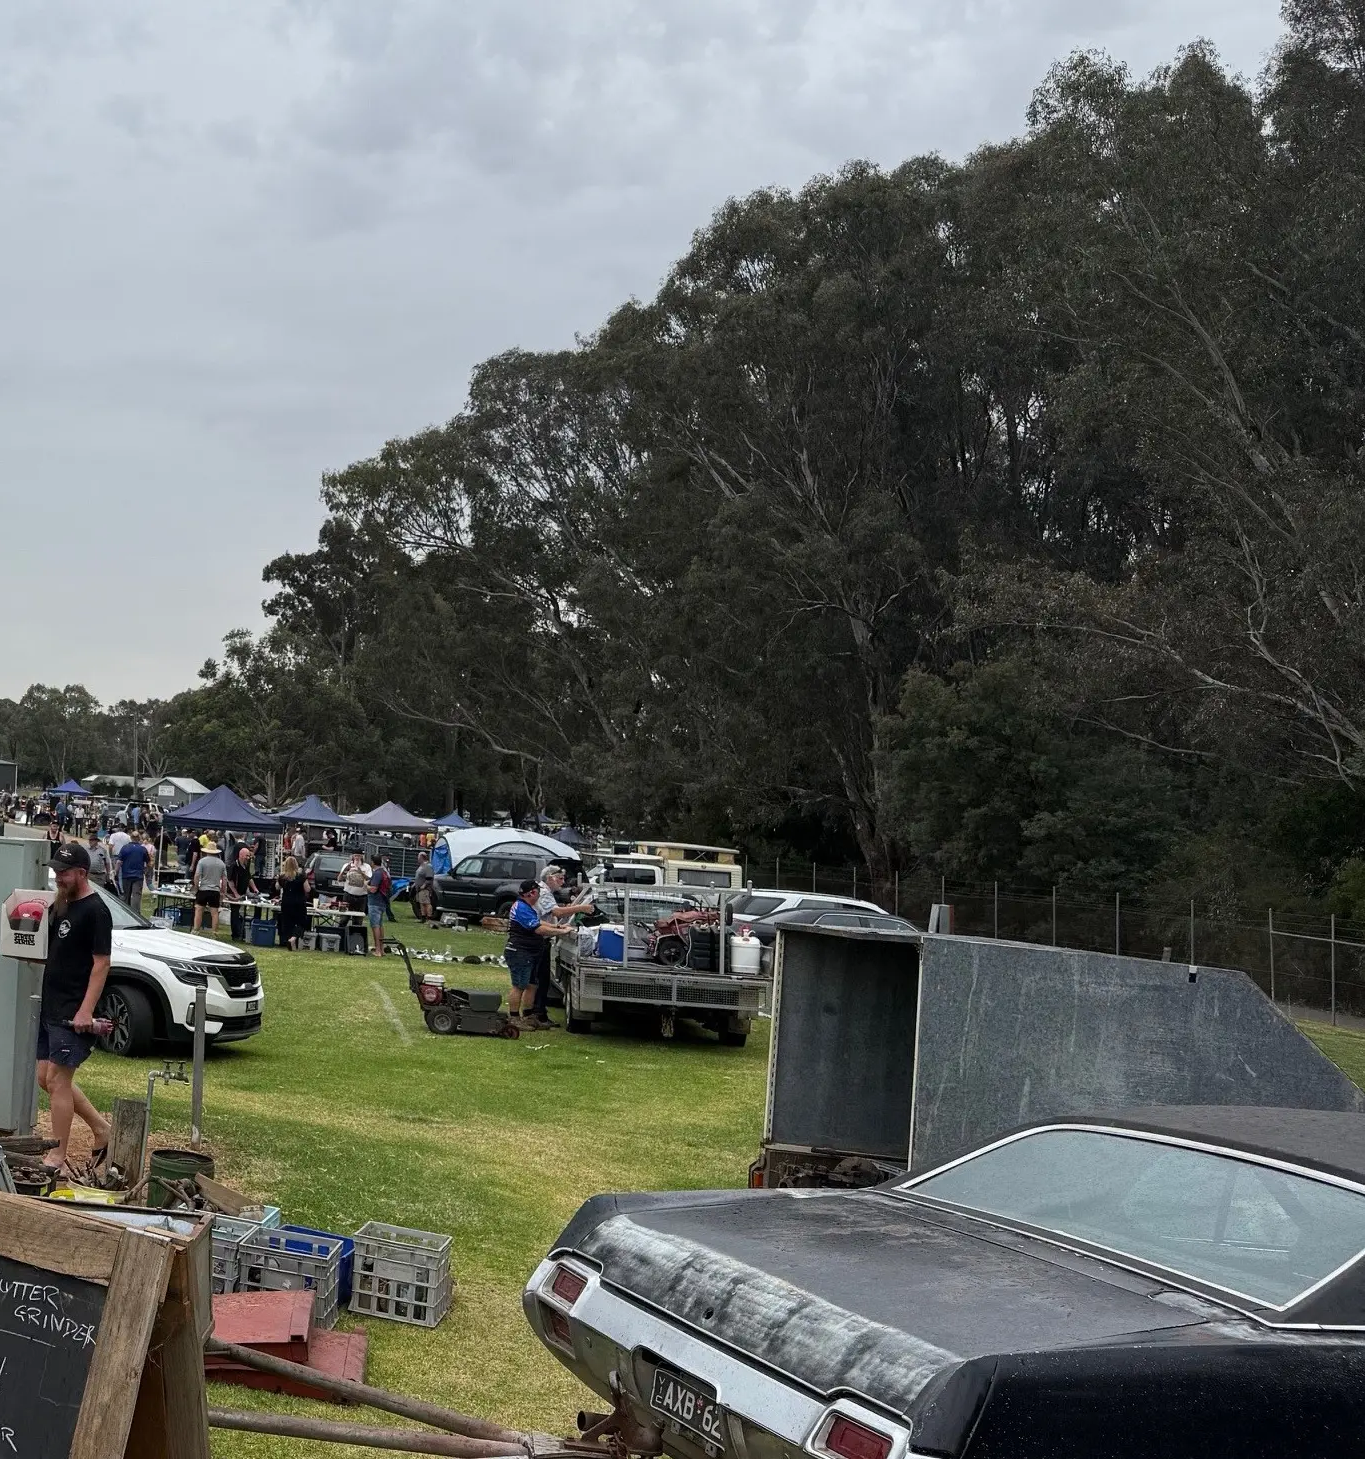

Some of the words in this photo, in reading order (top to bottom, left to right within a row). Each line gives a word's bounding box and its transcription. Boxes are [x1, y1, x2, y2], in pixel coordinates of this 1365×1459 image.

[14, 1305, 97, 1349] GRINDER
[655, 1376, 666, 1404] VIC
[663, 1381, 696, 1420] AXB
